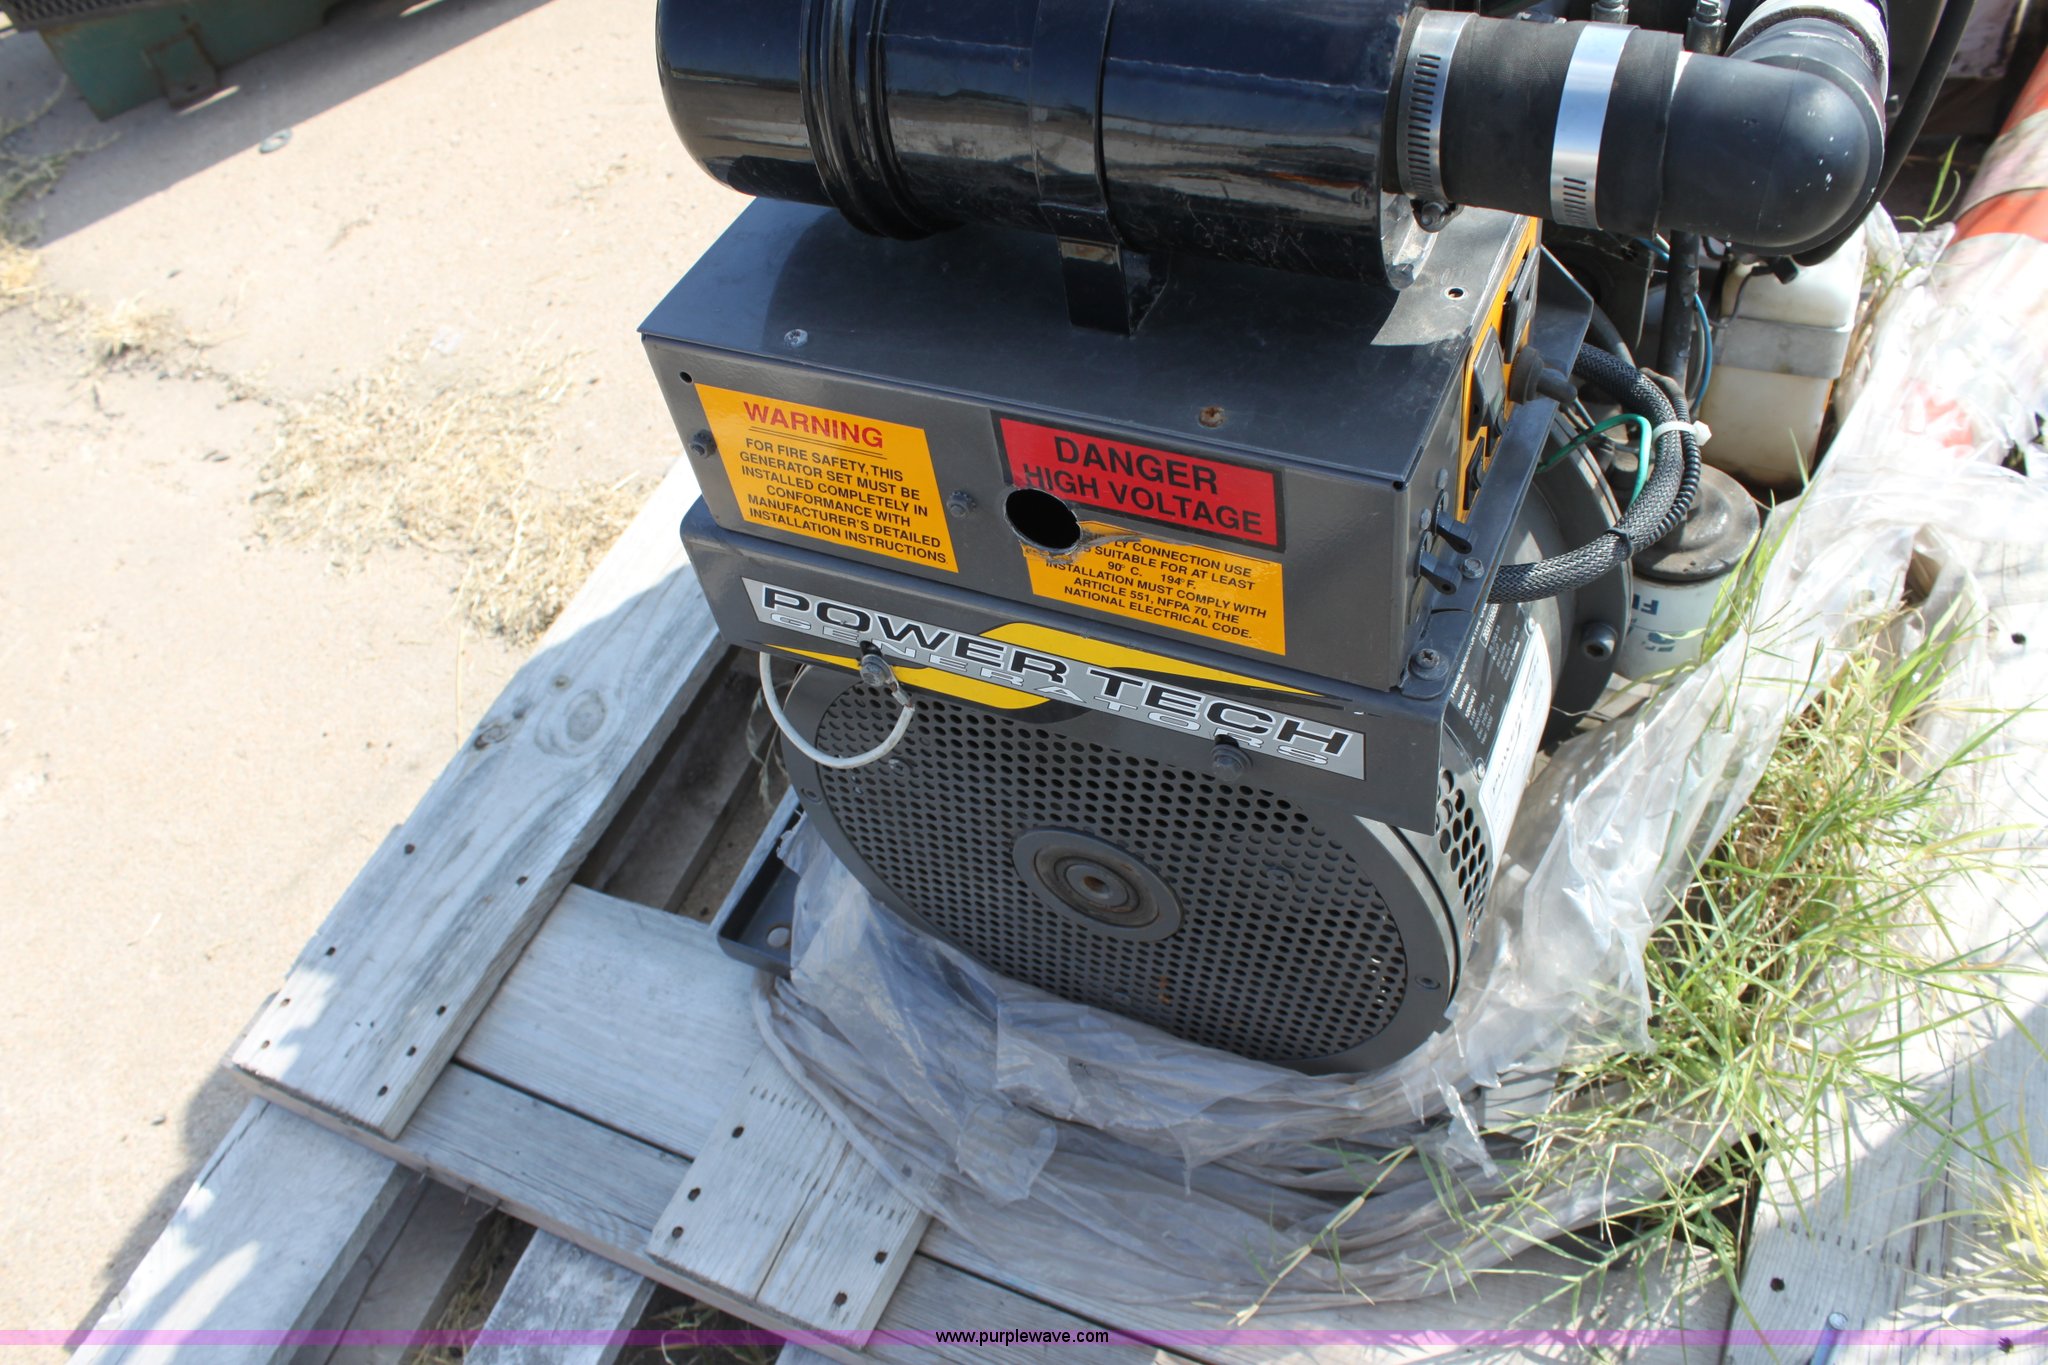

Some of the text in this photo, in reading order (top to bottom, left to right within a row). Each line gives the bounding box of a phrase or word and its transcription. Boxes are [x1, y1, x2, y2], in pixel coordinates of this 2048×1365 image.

[743, 401, 883, 449] WARNING
[739, 451, 921, 501] GENERATOR SET MUST BE
[746, 438, 904, 482] FOR FIRE SAFETY, THIS
[1054, 436, 1218, 495] DANGER
[741, 465, 928, 518] INSTALLED COMPLETELY IN
[766, 484, 911, 528] CONFORMANCE WITH
[1023, 463, 1263, 536] HIGH VOLTAGE
[747, 493, 941, 549] MANUFACTURER'S DETAILED
[749, 507, 842, 539] INSTALLATION
[1094, 546, 1256, 591] SUITABLE FOR AT LEAST
[1130, 566, 1143, 577] C.
[1186, 579, 1196, 590] F.
[1132, 542, 1220, 571] CONNECTION
[1224, 563, 1252, 578] USE
[1045, 560, 1267, 619] INSTALLATION MUST COMPLY WITH
[1064, 586, 1253, 639] NATIONAL ELECTRICAL CODE.
[1074, 577, 1240, 624] ARTICLE 551, NFPA 70, THE
[762, 584, 1353, 758] POWER TECH
[770, 612, 1329, 765] GENERATORS
